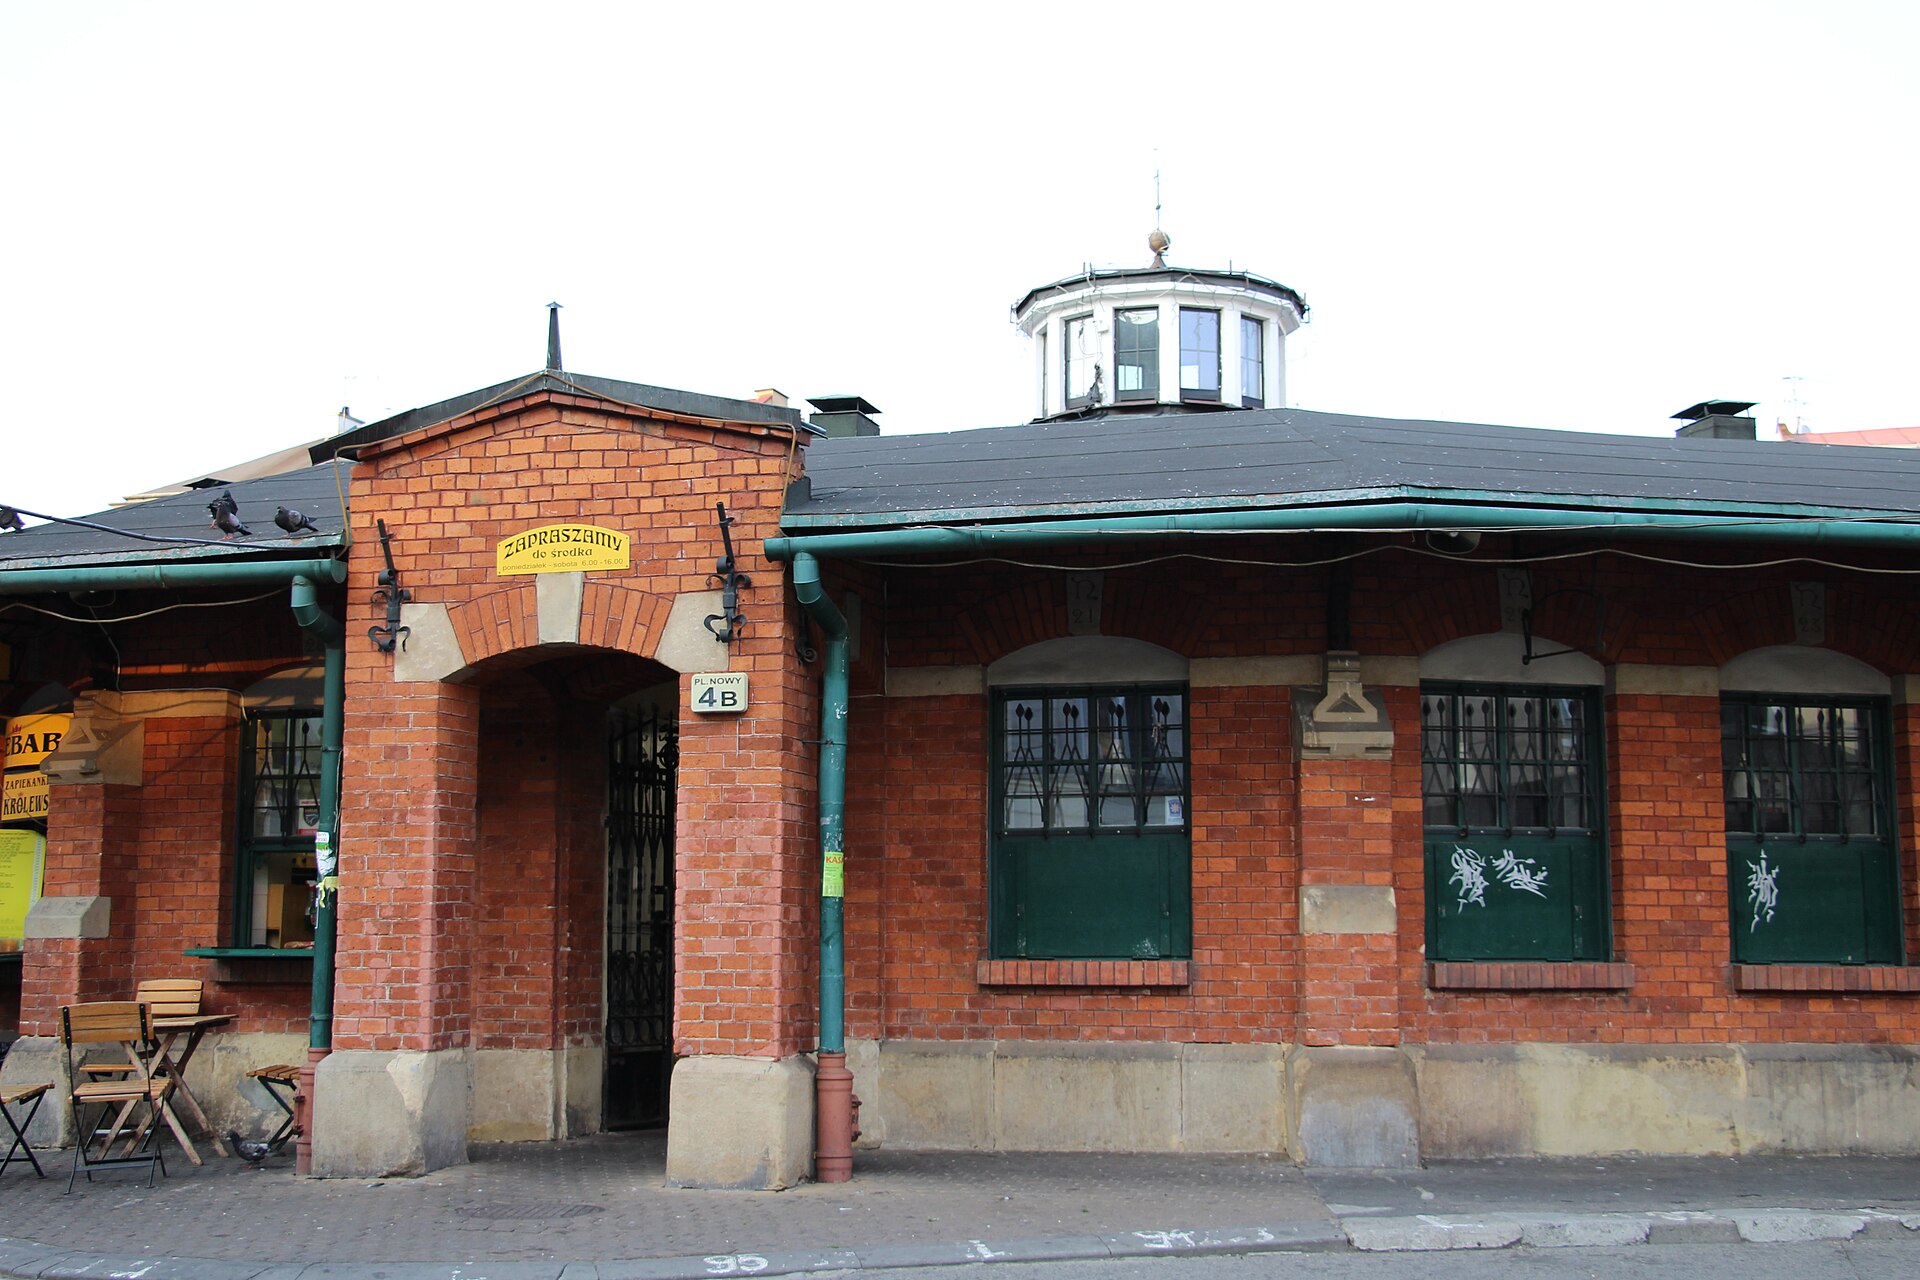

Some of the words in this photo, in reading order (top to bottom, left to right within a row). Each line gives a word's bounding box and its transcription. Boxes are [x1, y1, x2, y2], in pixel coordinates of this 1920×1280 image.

[503, 528, 622, 560] ZAPRASZAMY
[532, 549, 547, 559] do
[551, 547, 593, 558] środka
[502, 561, 547, 571] poniedziałek
[553, 560, 578, 568] sobota
[581, 559, 598, 567] 6.00
